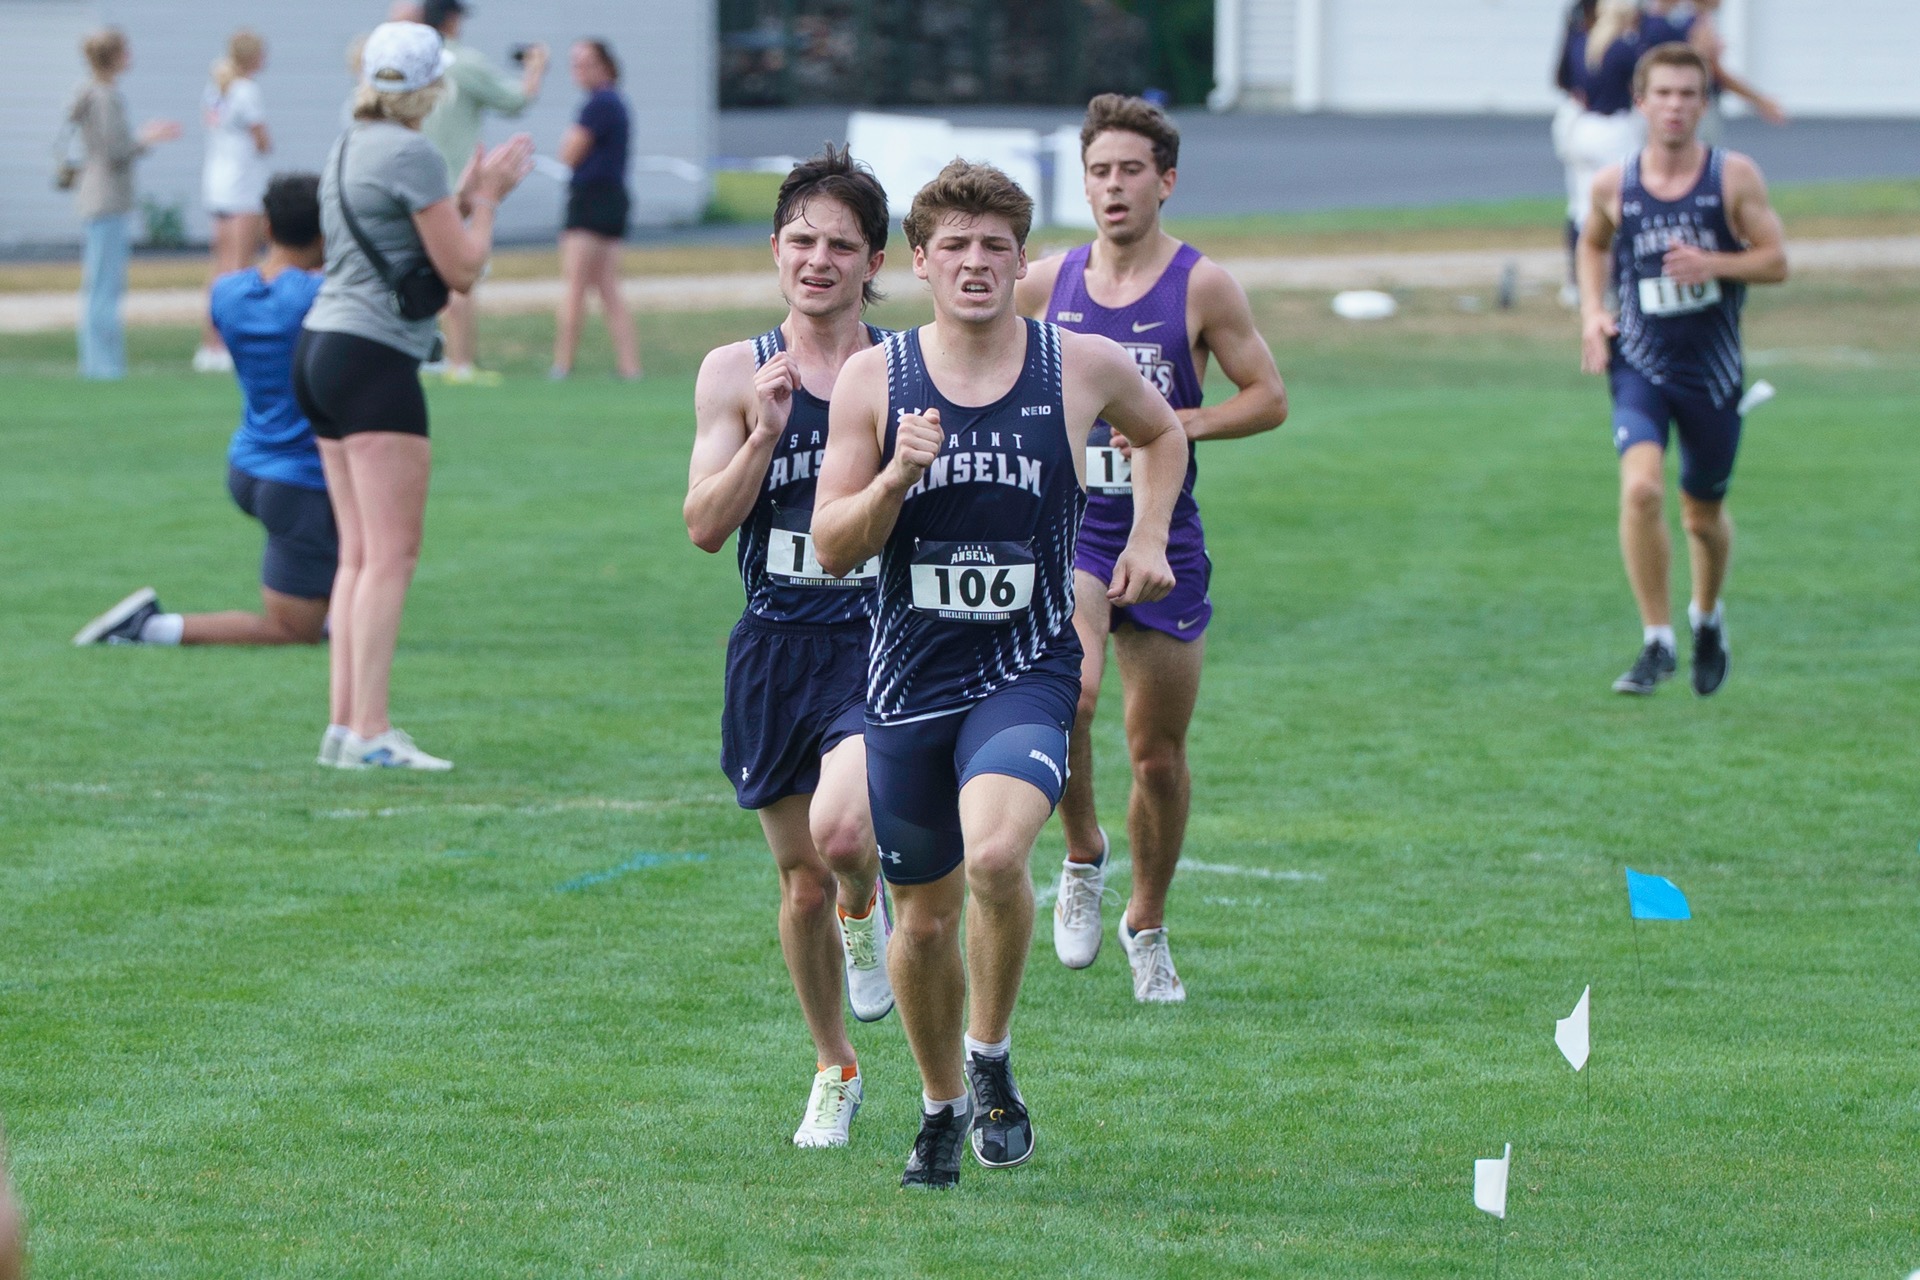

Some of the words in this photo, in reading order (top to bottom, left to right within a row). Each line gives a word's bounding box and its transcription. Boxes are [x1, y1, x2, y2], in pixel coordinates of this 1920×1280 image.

[1021, 405, 1051, 417] NE10
[948, 431, 1023, 449] AINT
[950, 550, 996, 565] ANSELM
[935, 568, 1016, 607] 106
